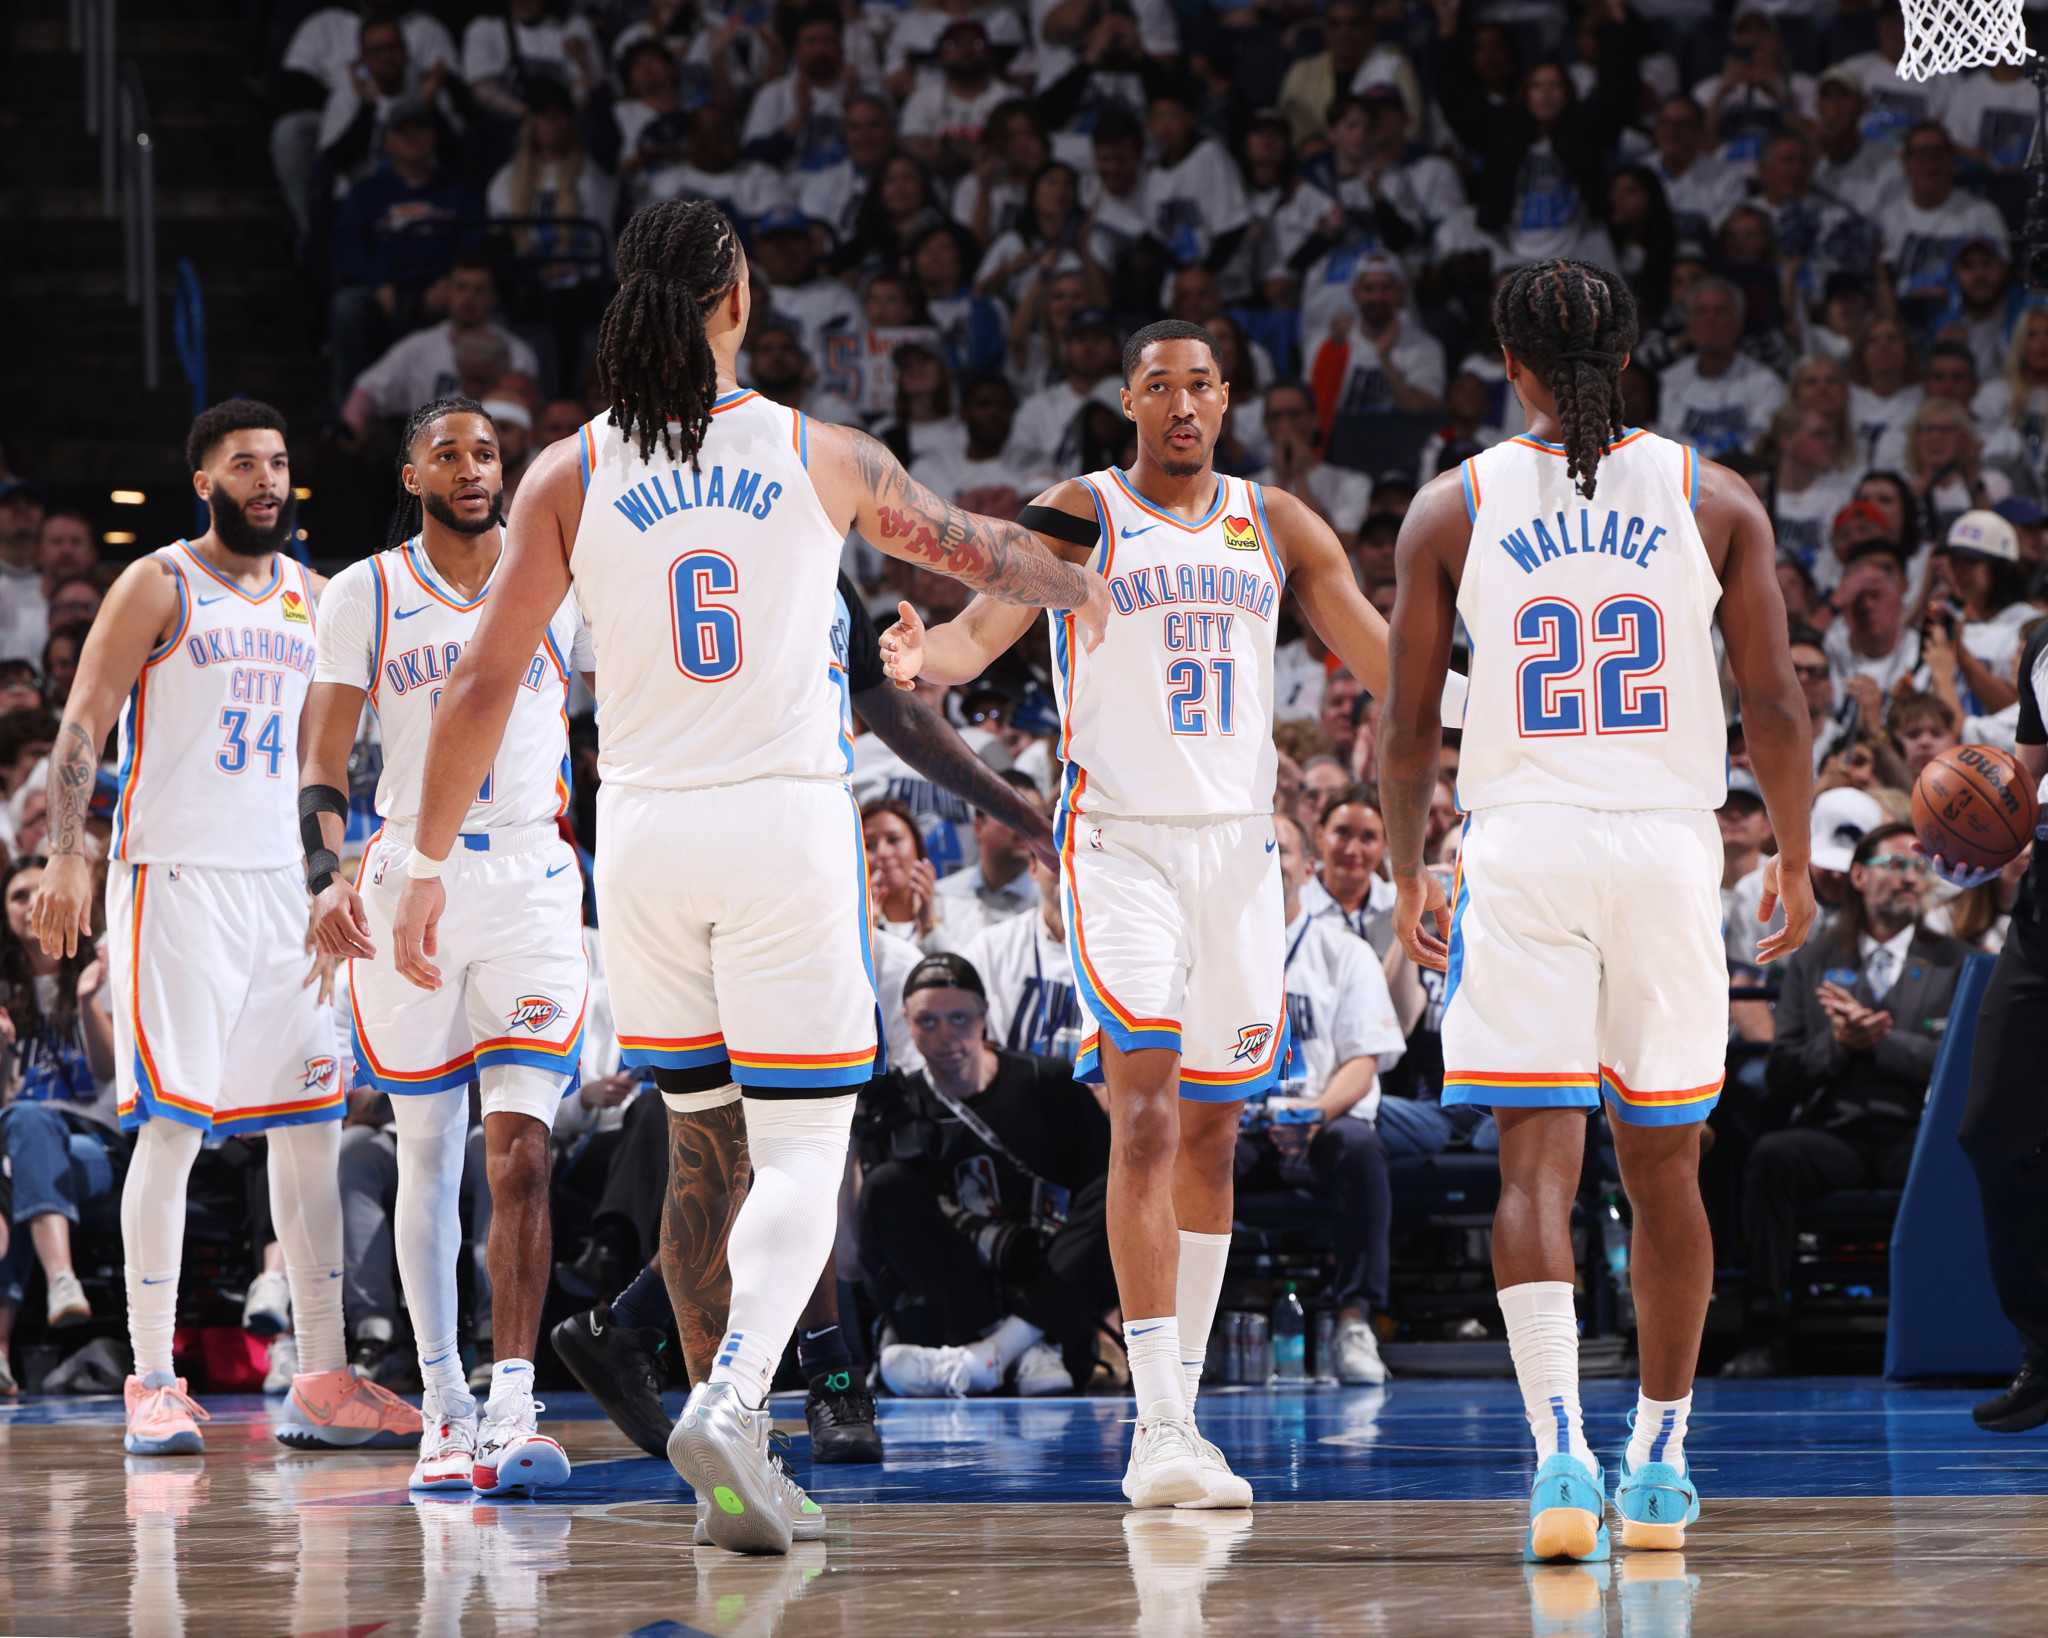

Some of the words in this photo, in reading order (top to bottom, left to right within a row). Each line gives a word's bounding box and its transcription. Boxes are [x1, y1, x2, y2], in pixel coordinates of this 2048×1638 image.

[613, 466, 783, 533] WILLIAMS
[1500, 508, 1667, 575] WALLACE
[668, 549, 743, 683] 6
[1108, 564, 1275, 623] OKLAHOMA
[186, 627, 316, 679] OKLAHOMA
[1164, 611, 1235, 652] CITY
[231, 667, 285, 706] CITY
[385, 641, 548, 697] OKLAA
[1167, 657, 1235, 736] 21
[1514, 593, 1668, 738] 22
[216, 707, 286, 778] 34
[1957, 748, 2019, 817] Wilson
[511, 1004, 553, 1025] OKC
[1234, 1030, 1269, 1059] OKC
